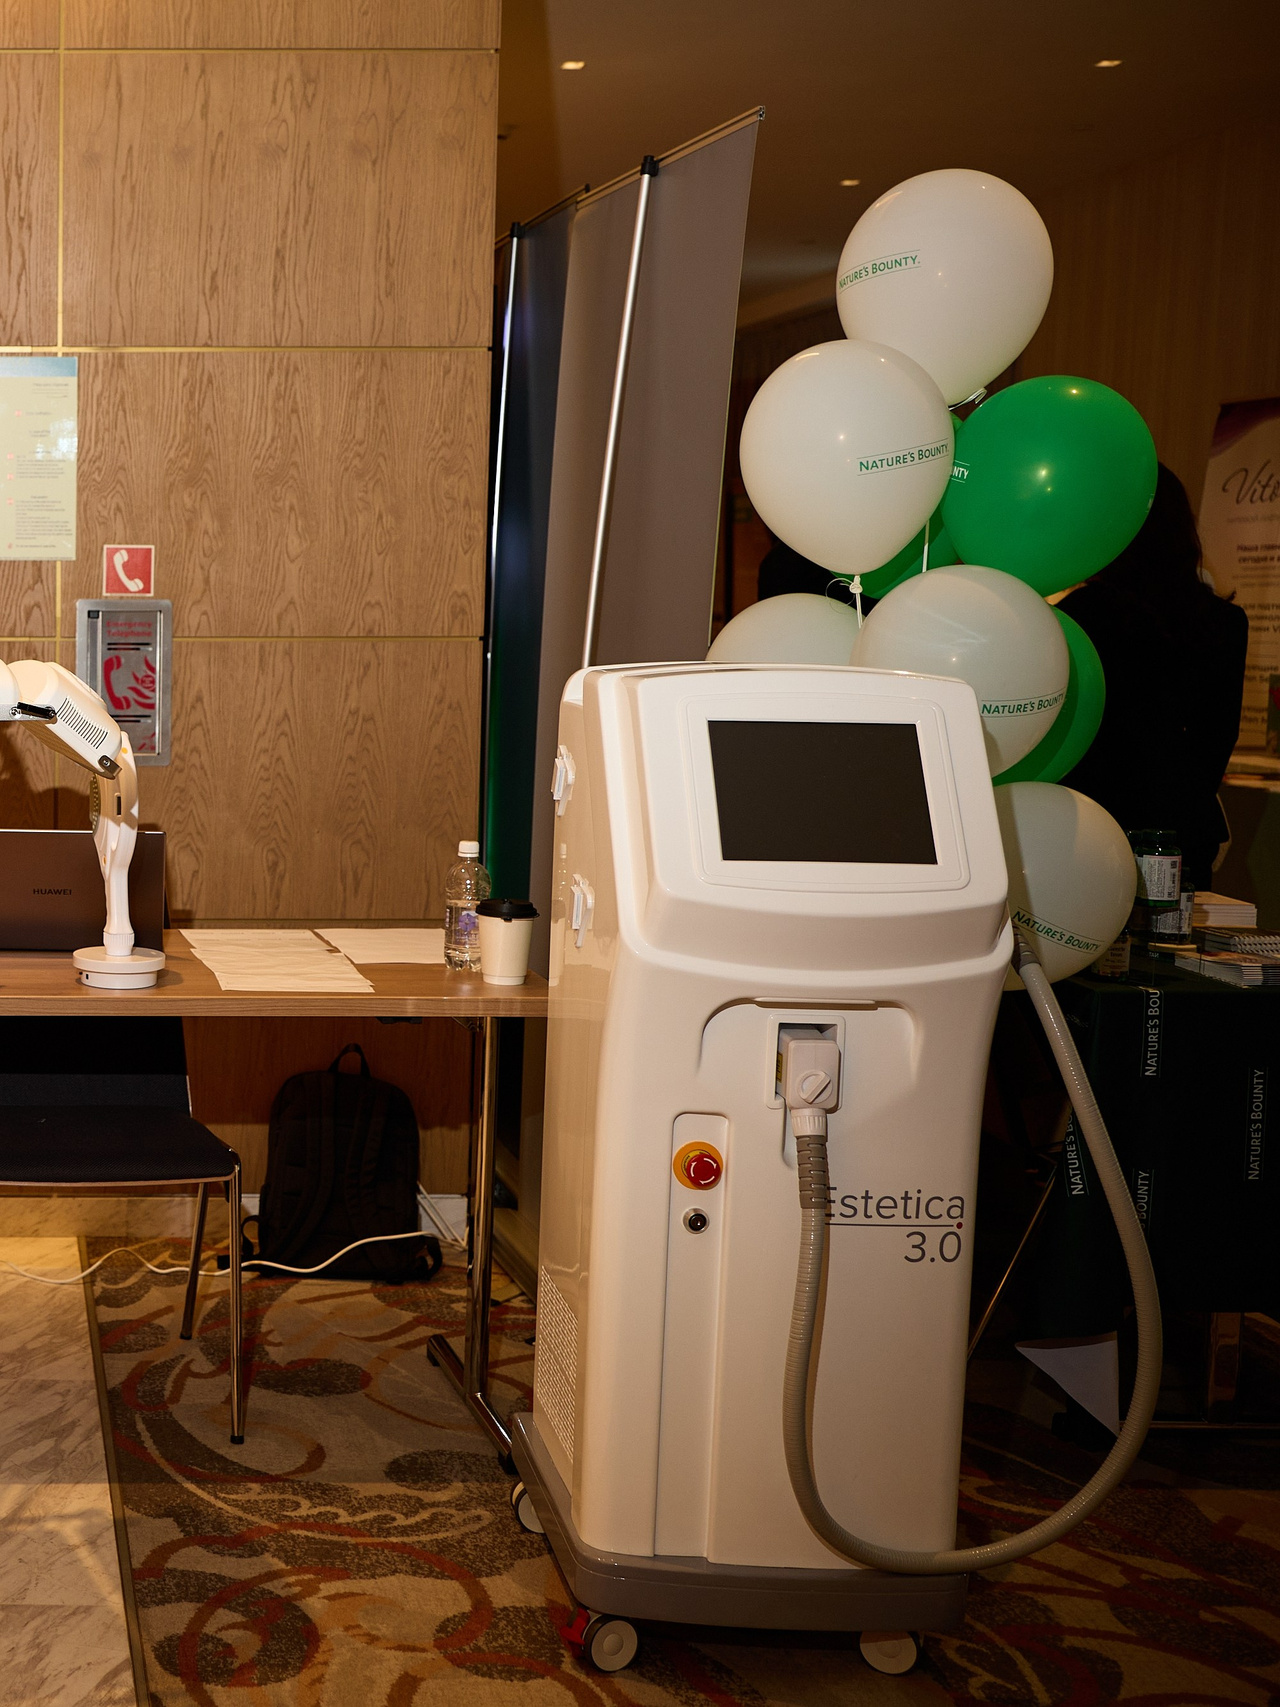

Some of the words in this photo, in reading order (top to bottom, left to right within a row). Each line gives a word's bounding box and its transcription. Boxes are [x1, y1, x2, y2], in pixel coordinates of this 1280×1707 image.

[838, 265, 869, 289] NATURE'S
[872, 253, 918, 275] BOUNTY
[858, 452, 915, 472] NATURE'S
[918, 442, 949, 461] BOUNTY
[952, 465, 969, 480] NTY
[981, 699, 1034, 715] NATURE'S
[32, 888, 72, 896] HUAWEI
[1012, 911, 1064, 942] NATURE'S
[1065, 933, 1102, 953] BOUNTY
[1144, 1019, 1160, 1076] NATURE'S
[1250, 1069, 1264, 1120] BOUNTY
[1066, 1135, 1086, 1196] NATURE'S
[1247, 1123, 1262, 1180] NATURE'S
[904, 1230, 962, 1264] 3.0
